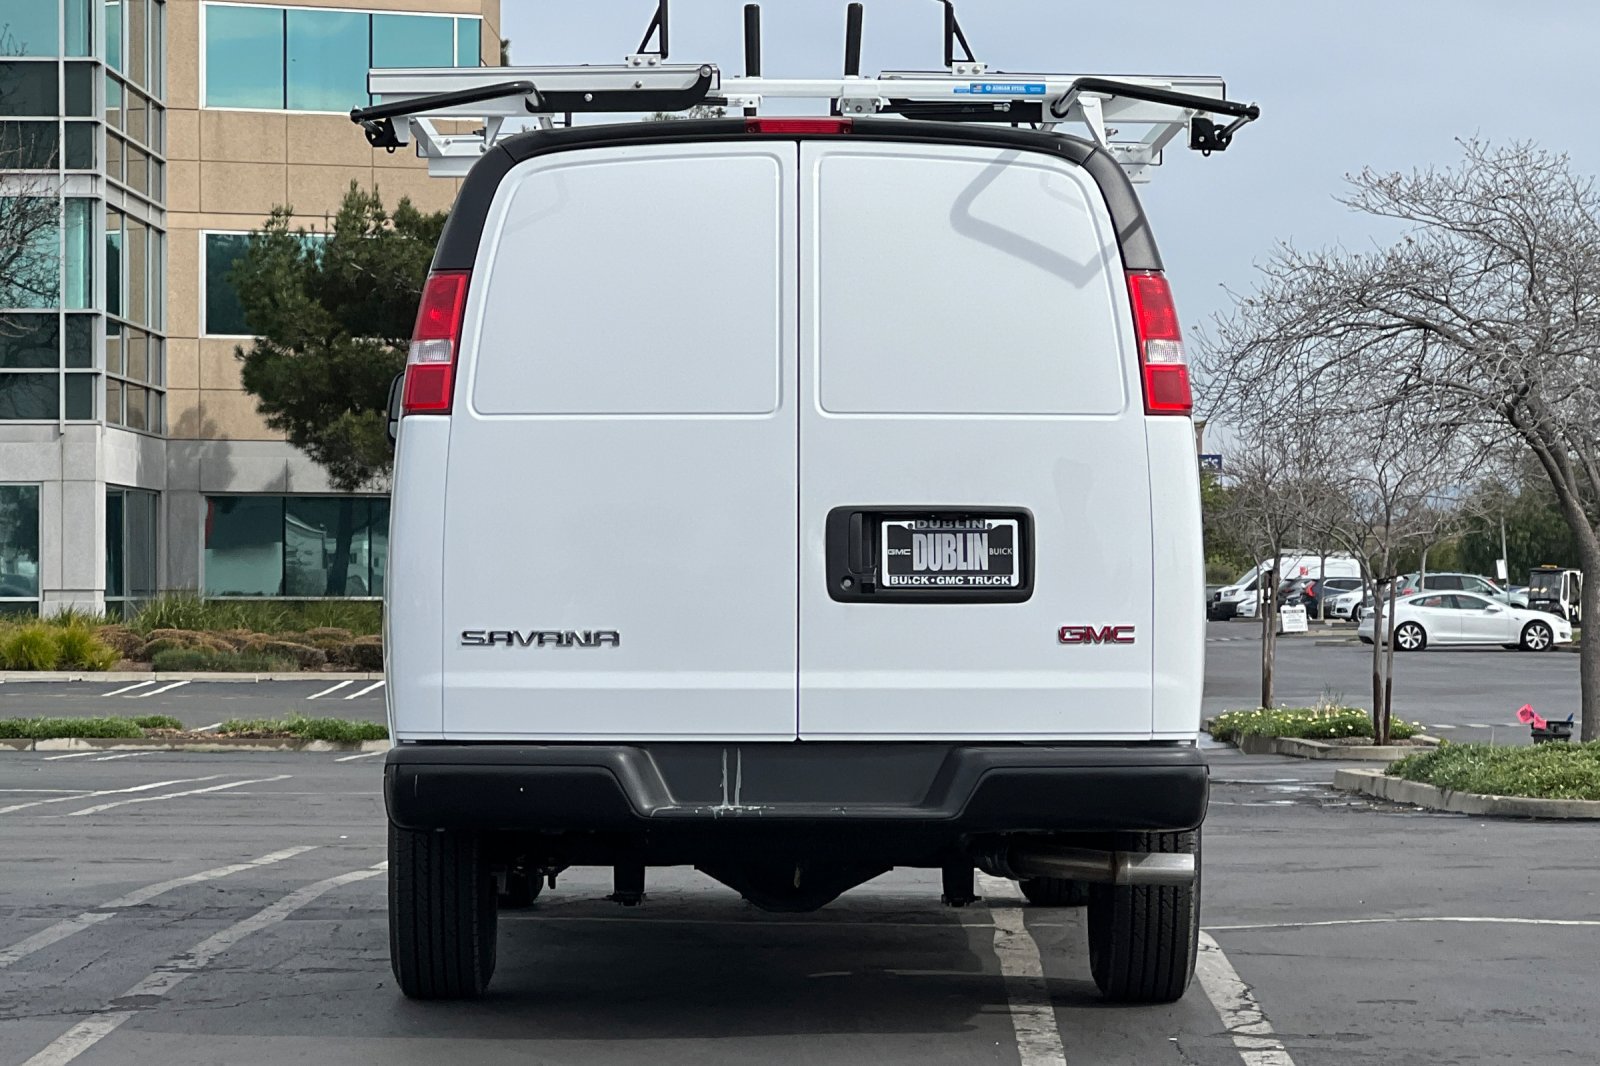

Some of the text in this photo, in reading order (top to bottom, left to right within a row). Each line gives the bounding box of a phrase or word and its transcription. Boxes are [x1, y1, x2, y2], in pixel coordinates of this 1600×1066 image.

[916, 519, 985, 529] DUBLIN
[912, 533, 989, 571] DUBLIN
[989, 547, 1013, 556] BUICK
[968, 576, 1010, 585] TRUCK
[461, 630, 620, 647] SAVANA
[1058, 625, 1135, 644] GMC
